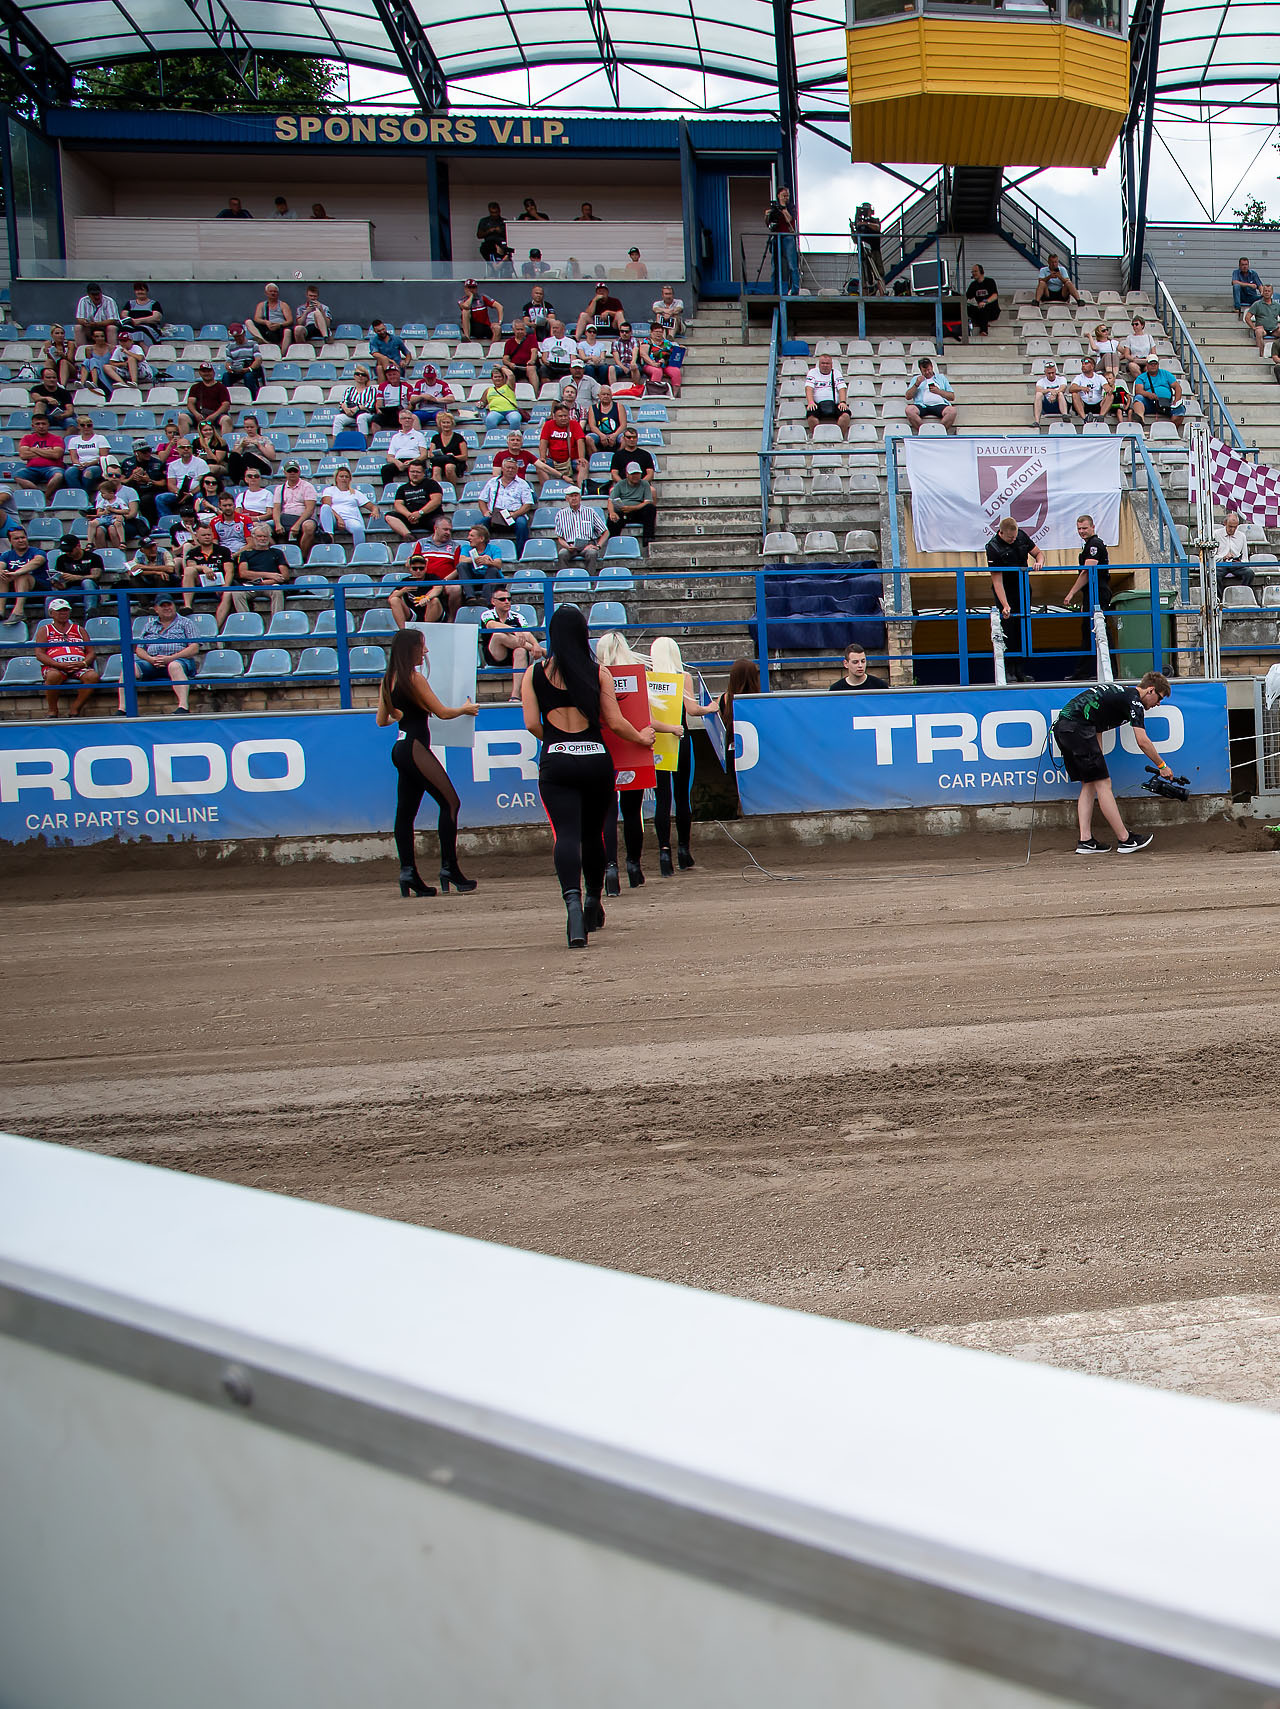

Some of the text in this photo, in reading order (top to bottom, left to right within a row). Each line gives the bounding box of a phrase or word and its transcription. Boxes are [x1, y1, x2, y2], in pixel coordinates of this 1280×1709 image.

[275, 116, 570, 144] SPONSORS V.I.P.
[976, 446, 1047, 454] DAUGAVPILS
[985, 459, 1043, 517] LOKOMOTIV
[648, 682, 670, 691] PTIBET
[939, 773, 975, 789] CAR
[981, 770, 1037, 787] PARTS
[497, 792, 536, 808] CAR
[26, 806, 219, 830] CAR PARTS ONLINE
